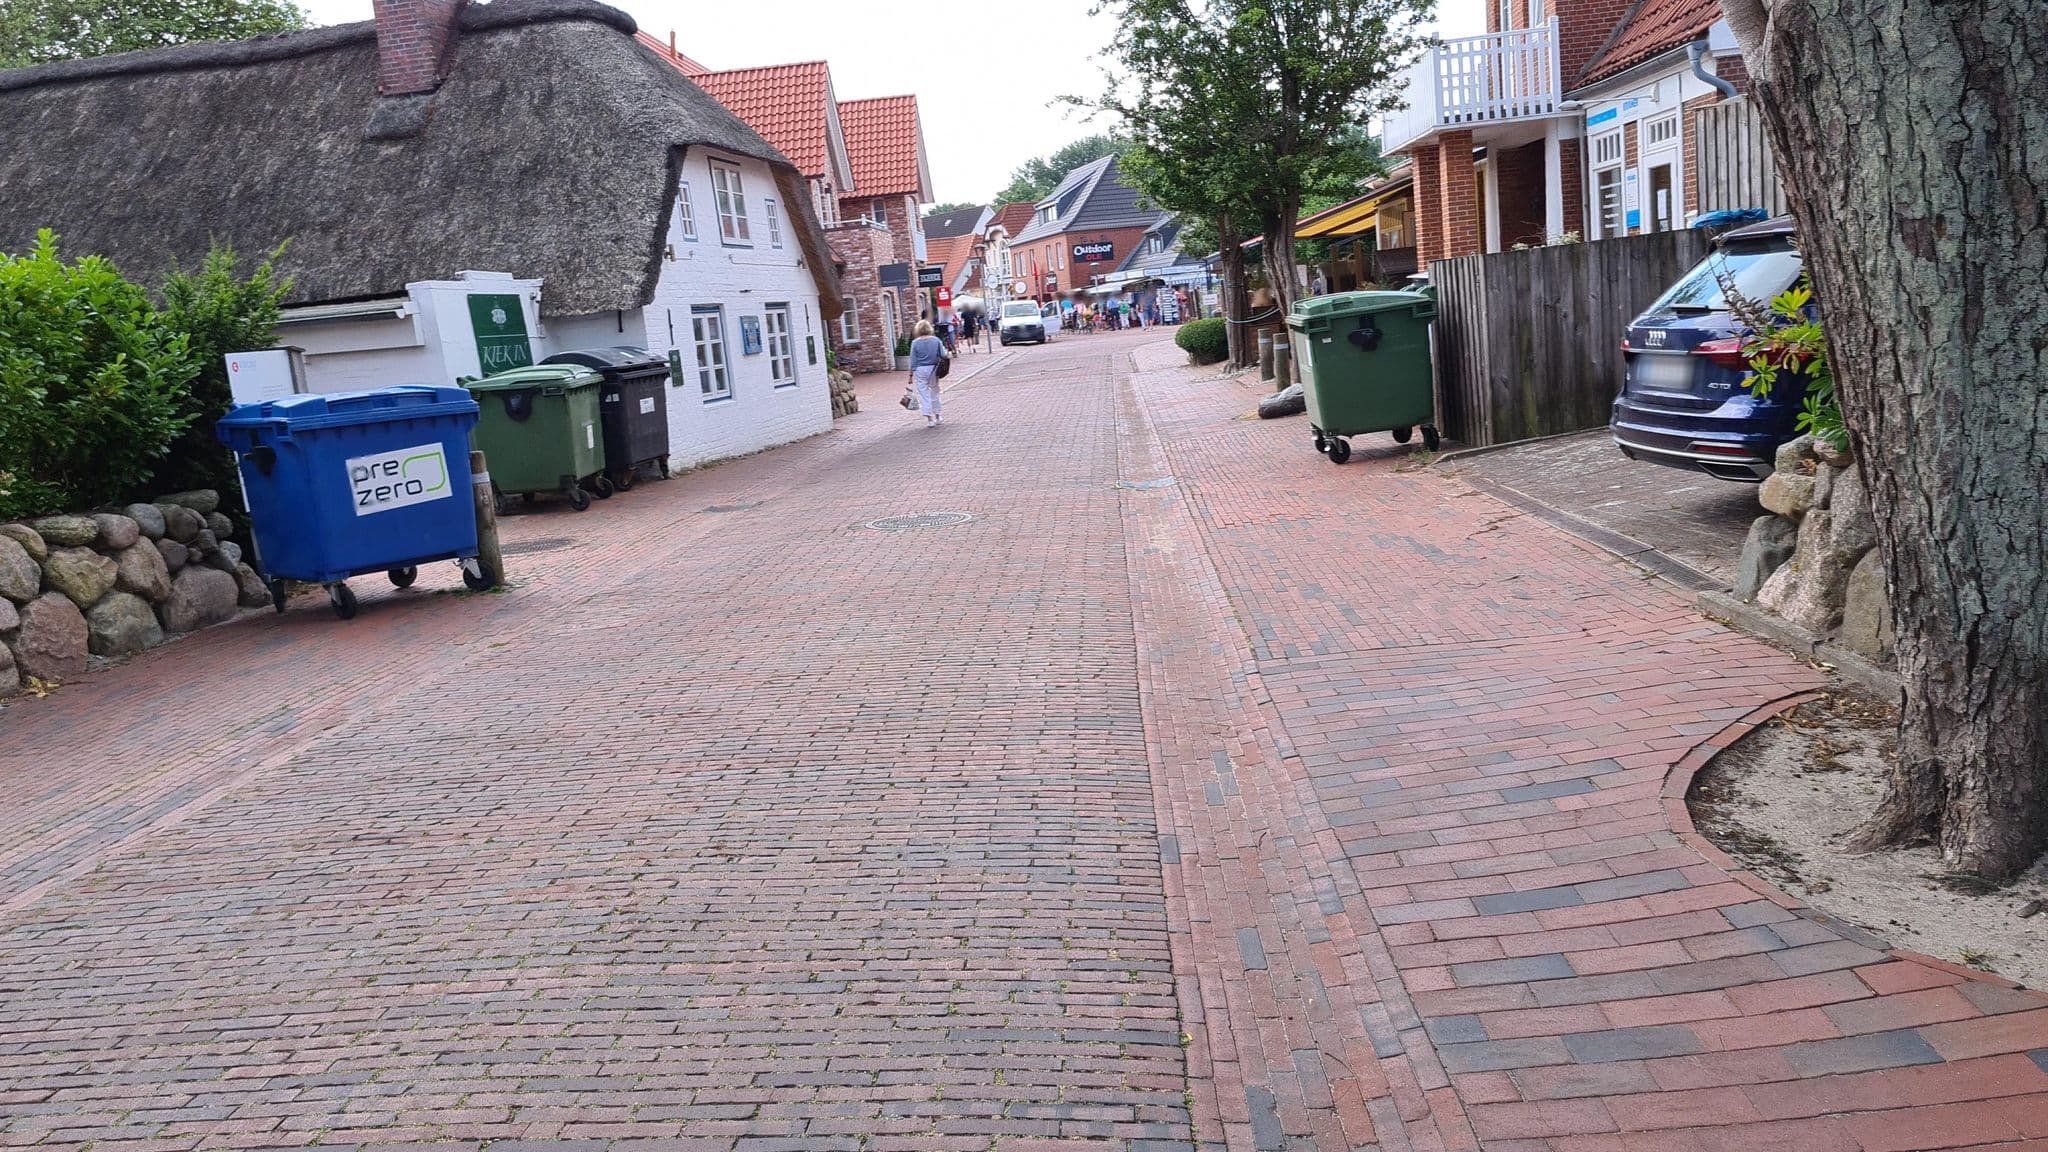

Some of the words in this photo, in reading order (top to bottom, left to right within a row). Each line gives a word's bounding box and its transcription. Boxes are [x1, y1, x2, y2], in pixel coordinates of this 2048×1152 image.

[1074, 244, 1112, 256] Outdoor
[482, 345, 516, 368] KIEK
[352, 460, 399, 487] pre
[356, 479, 423, 506] zero
